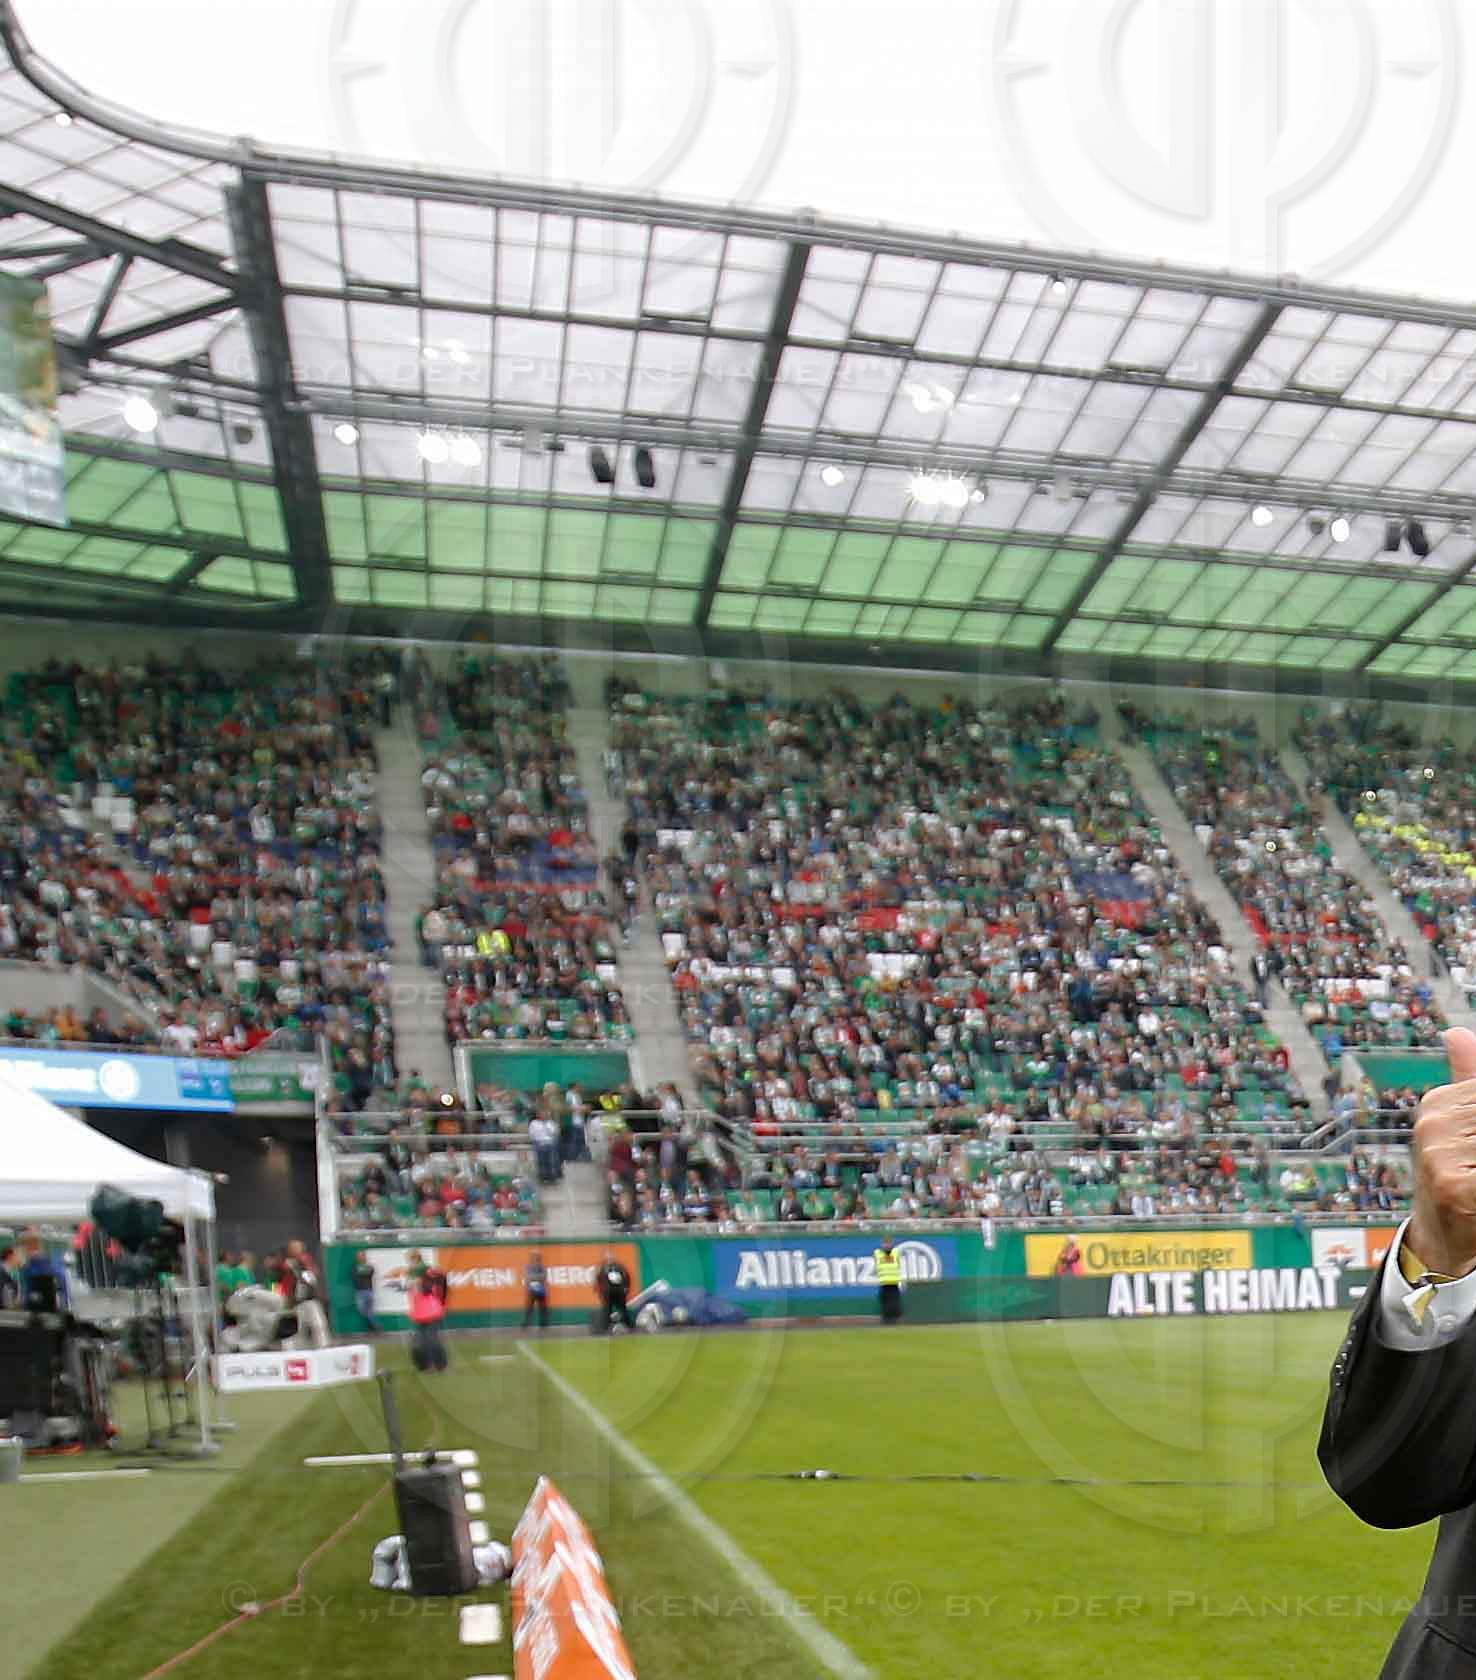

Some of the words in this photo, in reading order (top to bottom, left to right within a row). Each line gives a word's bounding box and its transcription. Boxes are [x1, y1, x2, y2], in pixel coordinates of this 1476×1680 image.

[735, 1250, 878, 1289] Allianz
[1107, 1271, 1196, 1316] ALTE
[1202, 1266, 1341, 1312] HEIMAT
